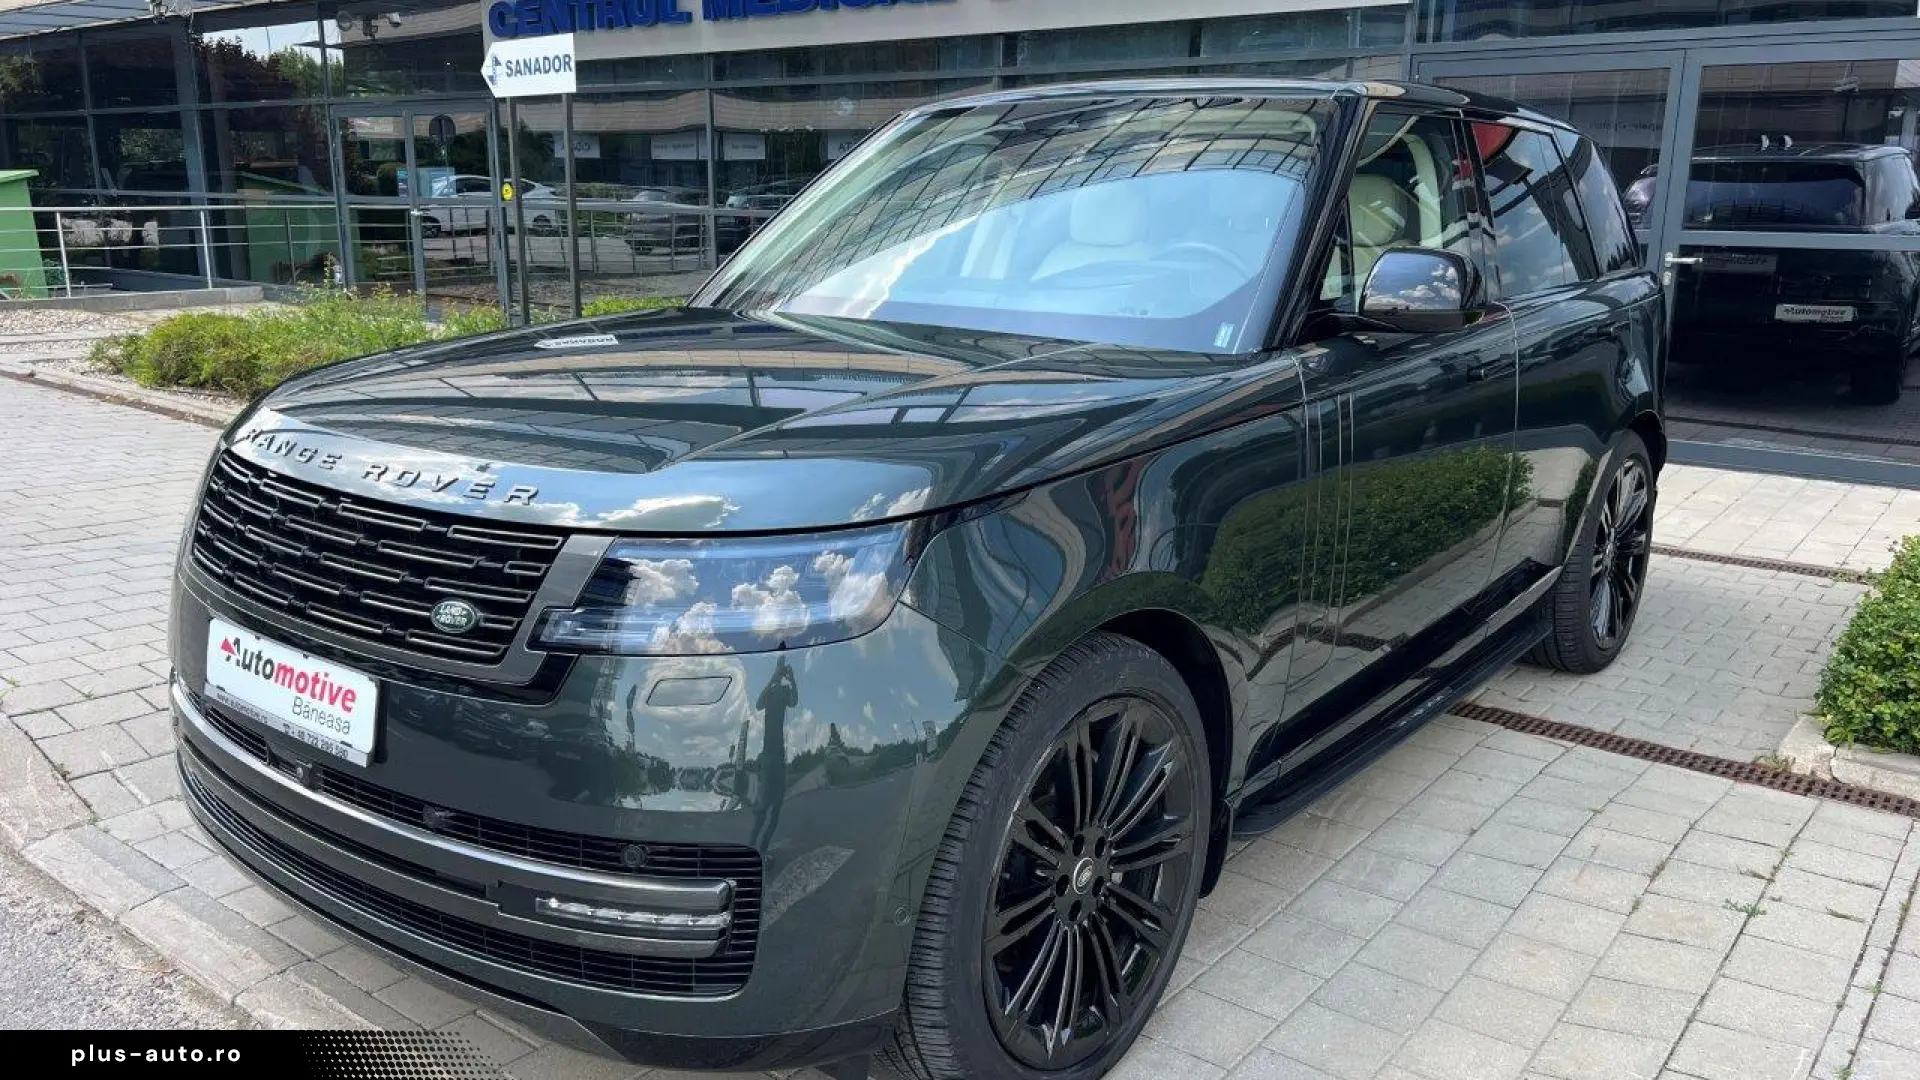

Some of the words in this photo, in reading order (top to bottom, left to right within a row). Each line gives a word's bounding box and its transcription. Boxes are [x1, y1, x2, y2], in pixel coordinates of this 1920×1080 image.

[505, 54, 573, 78] SANADOR
[249, 428, 342, 470] RANGE
[361, 463, 540, 506] ROVER
[220, 636, 357, 713] Automotive
